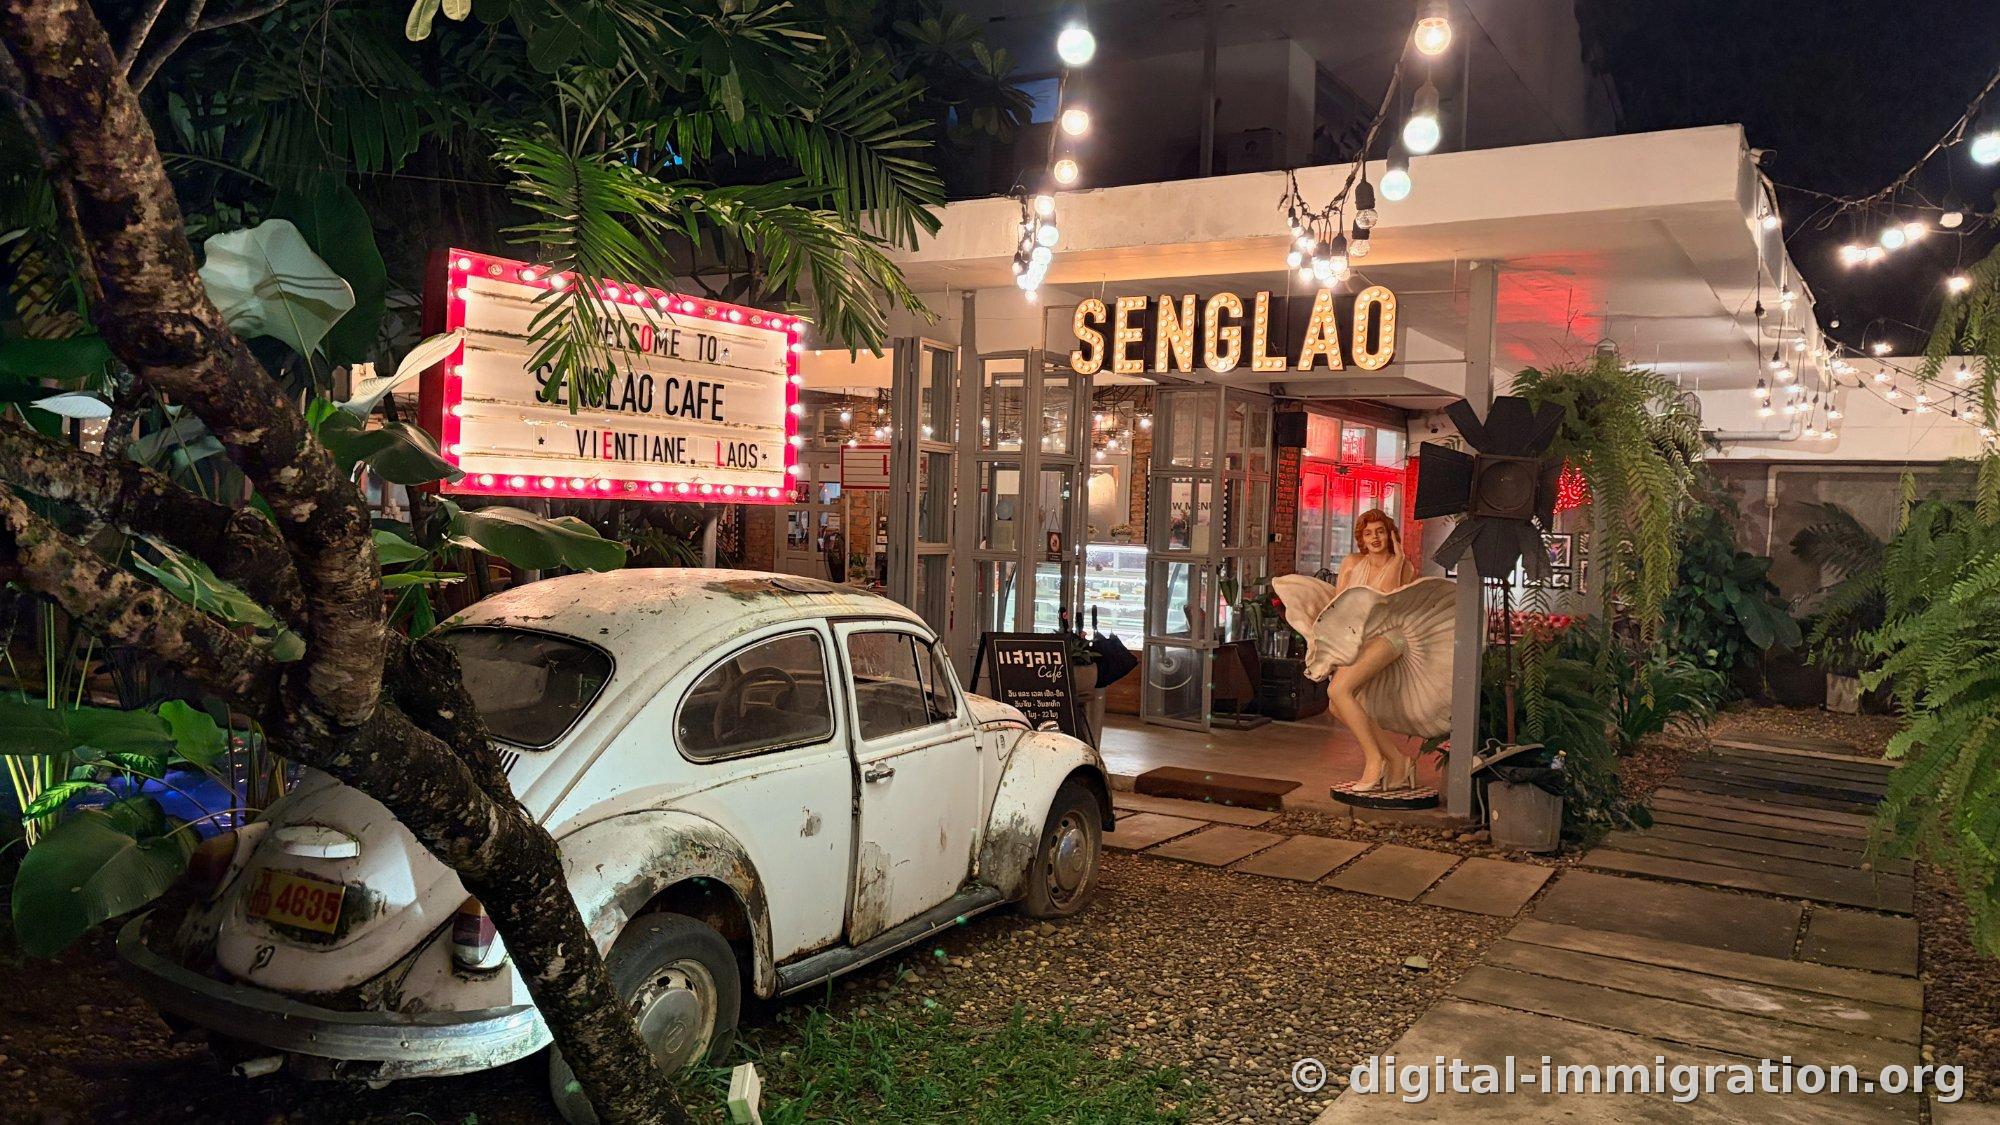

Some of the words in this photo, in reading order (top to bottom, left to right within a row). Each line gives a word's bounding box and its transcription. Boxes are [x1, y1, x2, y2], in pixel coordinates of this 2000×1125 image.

[1070, 285, 1397, 375] SENGLAO
[697, 333, 717, 362] TO
[665, 377, 725, 421] CAFE
[715, 440, 758, 469] LAOS
[1037, 664, 1064, 683] Café
